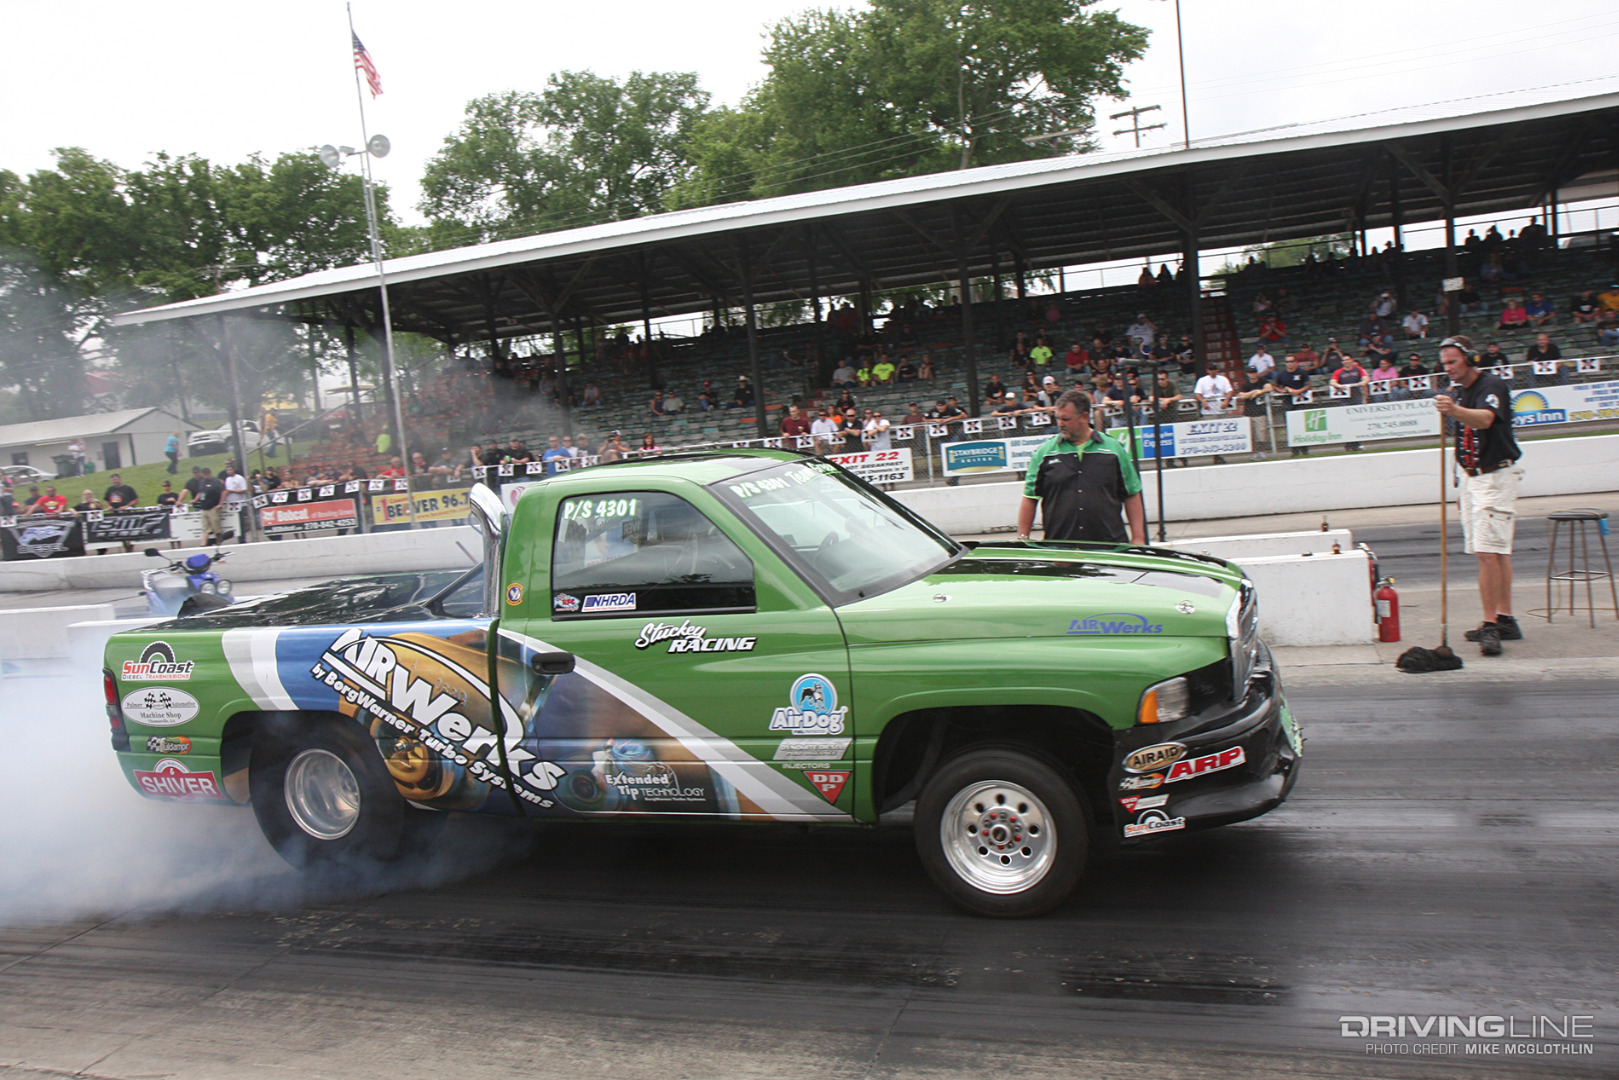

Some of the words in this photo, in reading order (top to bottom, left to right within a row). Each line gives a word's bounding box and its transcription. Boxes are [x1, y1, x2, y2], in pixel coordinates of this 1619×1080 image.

[1346, 403, 1402, 415] UNIVERSITY
[1512, 414, 1535, 425] ays
[1537, 412, 1564, 422] Inn
[1143, 439, 1173, 449] Expess
[829, 454, 869, 465] EXIT
[875, 452, 899, 461] 22
[953, 446, 998, 458] STAYBRIDGE
[277, 508, 308, 521] Bobcat
[387, 498, 438, 517] BEVER
[564, 501, 593, 520] P/S
[595, 499, 636, 518] 4301
[585, 594, 636, 608] NHRDA
[635, 619, 706, 648] Stuckey
[668, 637, 757, 653] RACING
[123, 661, 193, 674] SunCoast
[166, 711, 182, 720] Shop
[311, 664, 327, 685] by
[322, 670, 416, 737] BorgWarner
[418, 730, 469, 765] Turbo
[771, 708, 843, 735] AirDog
[1133, 746, 1179, 768] AIRAID
[1169, 747, 1241, 780] ARP
[782, 762, 831, 770] INJECTORS
[141, 777, 218, 795] SHIVER
[605, 771, 669, 786] Extended
[618, 786, 639, 801] Tip
[640, 788, 705, 797] TECHNOLOGY
[1125, 816, 1185, 834] SunCoast
